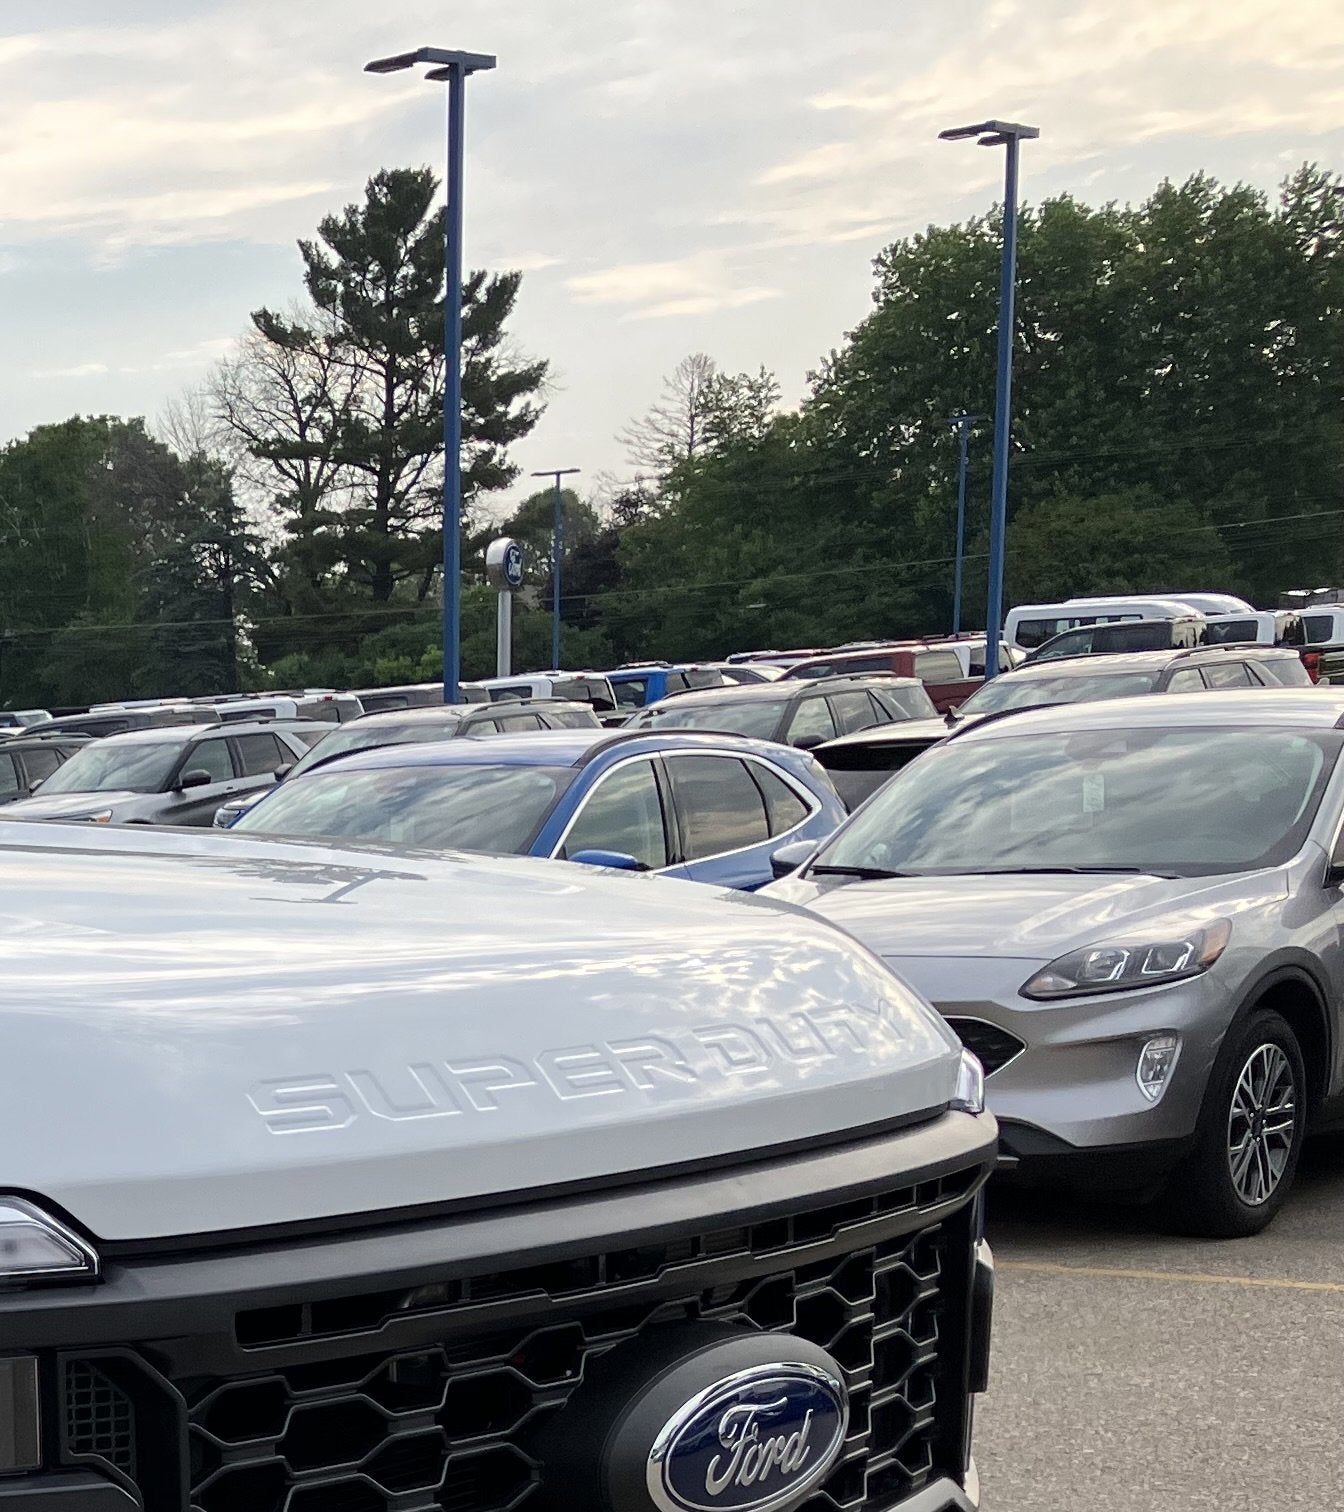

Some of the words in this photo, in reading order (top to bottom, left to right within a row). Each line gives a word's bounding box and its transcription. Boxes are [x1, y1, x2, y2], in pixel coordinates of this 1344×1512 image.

[245, 1034, 696, 1135] SUPER
[706, 1000, 911, 1077] DUTY
[705, 1396, 815, 1498] Ford
